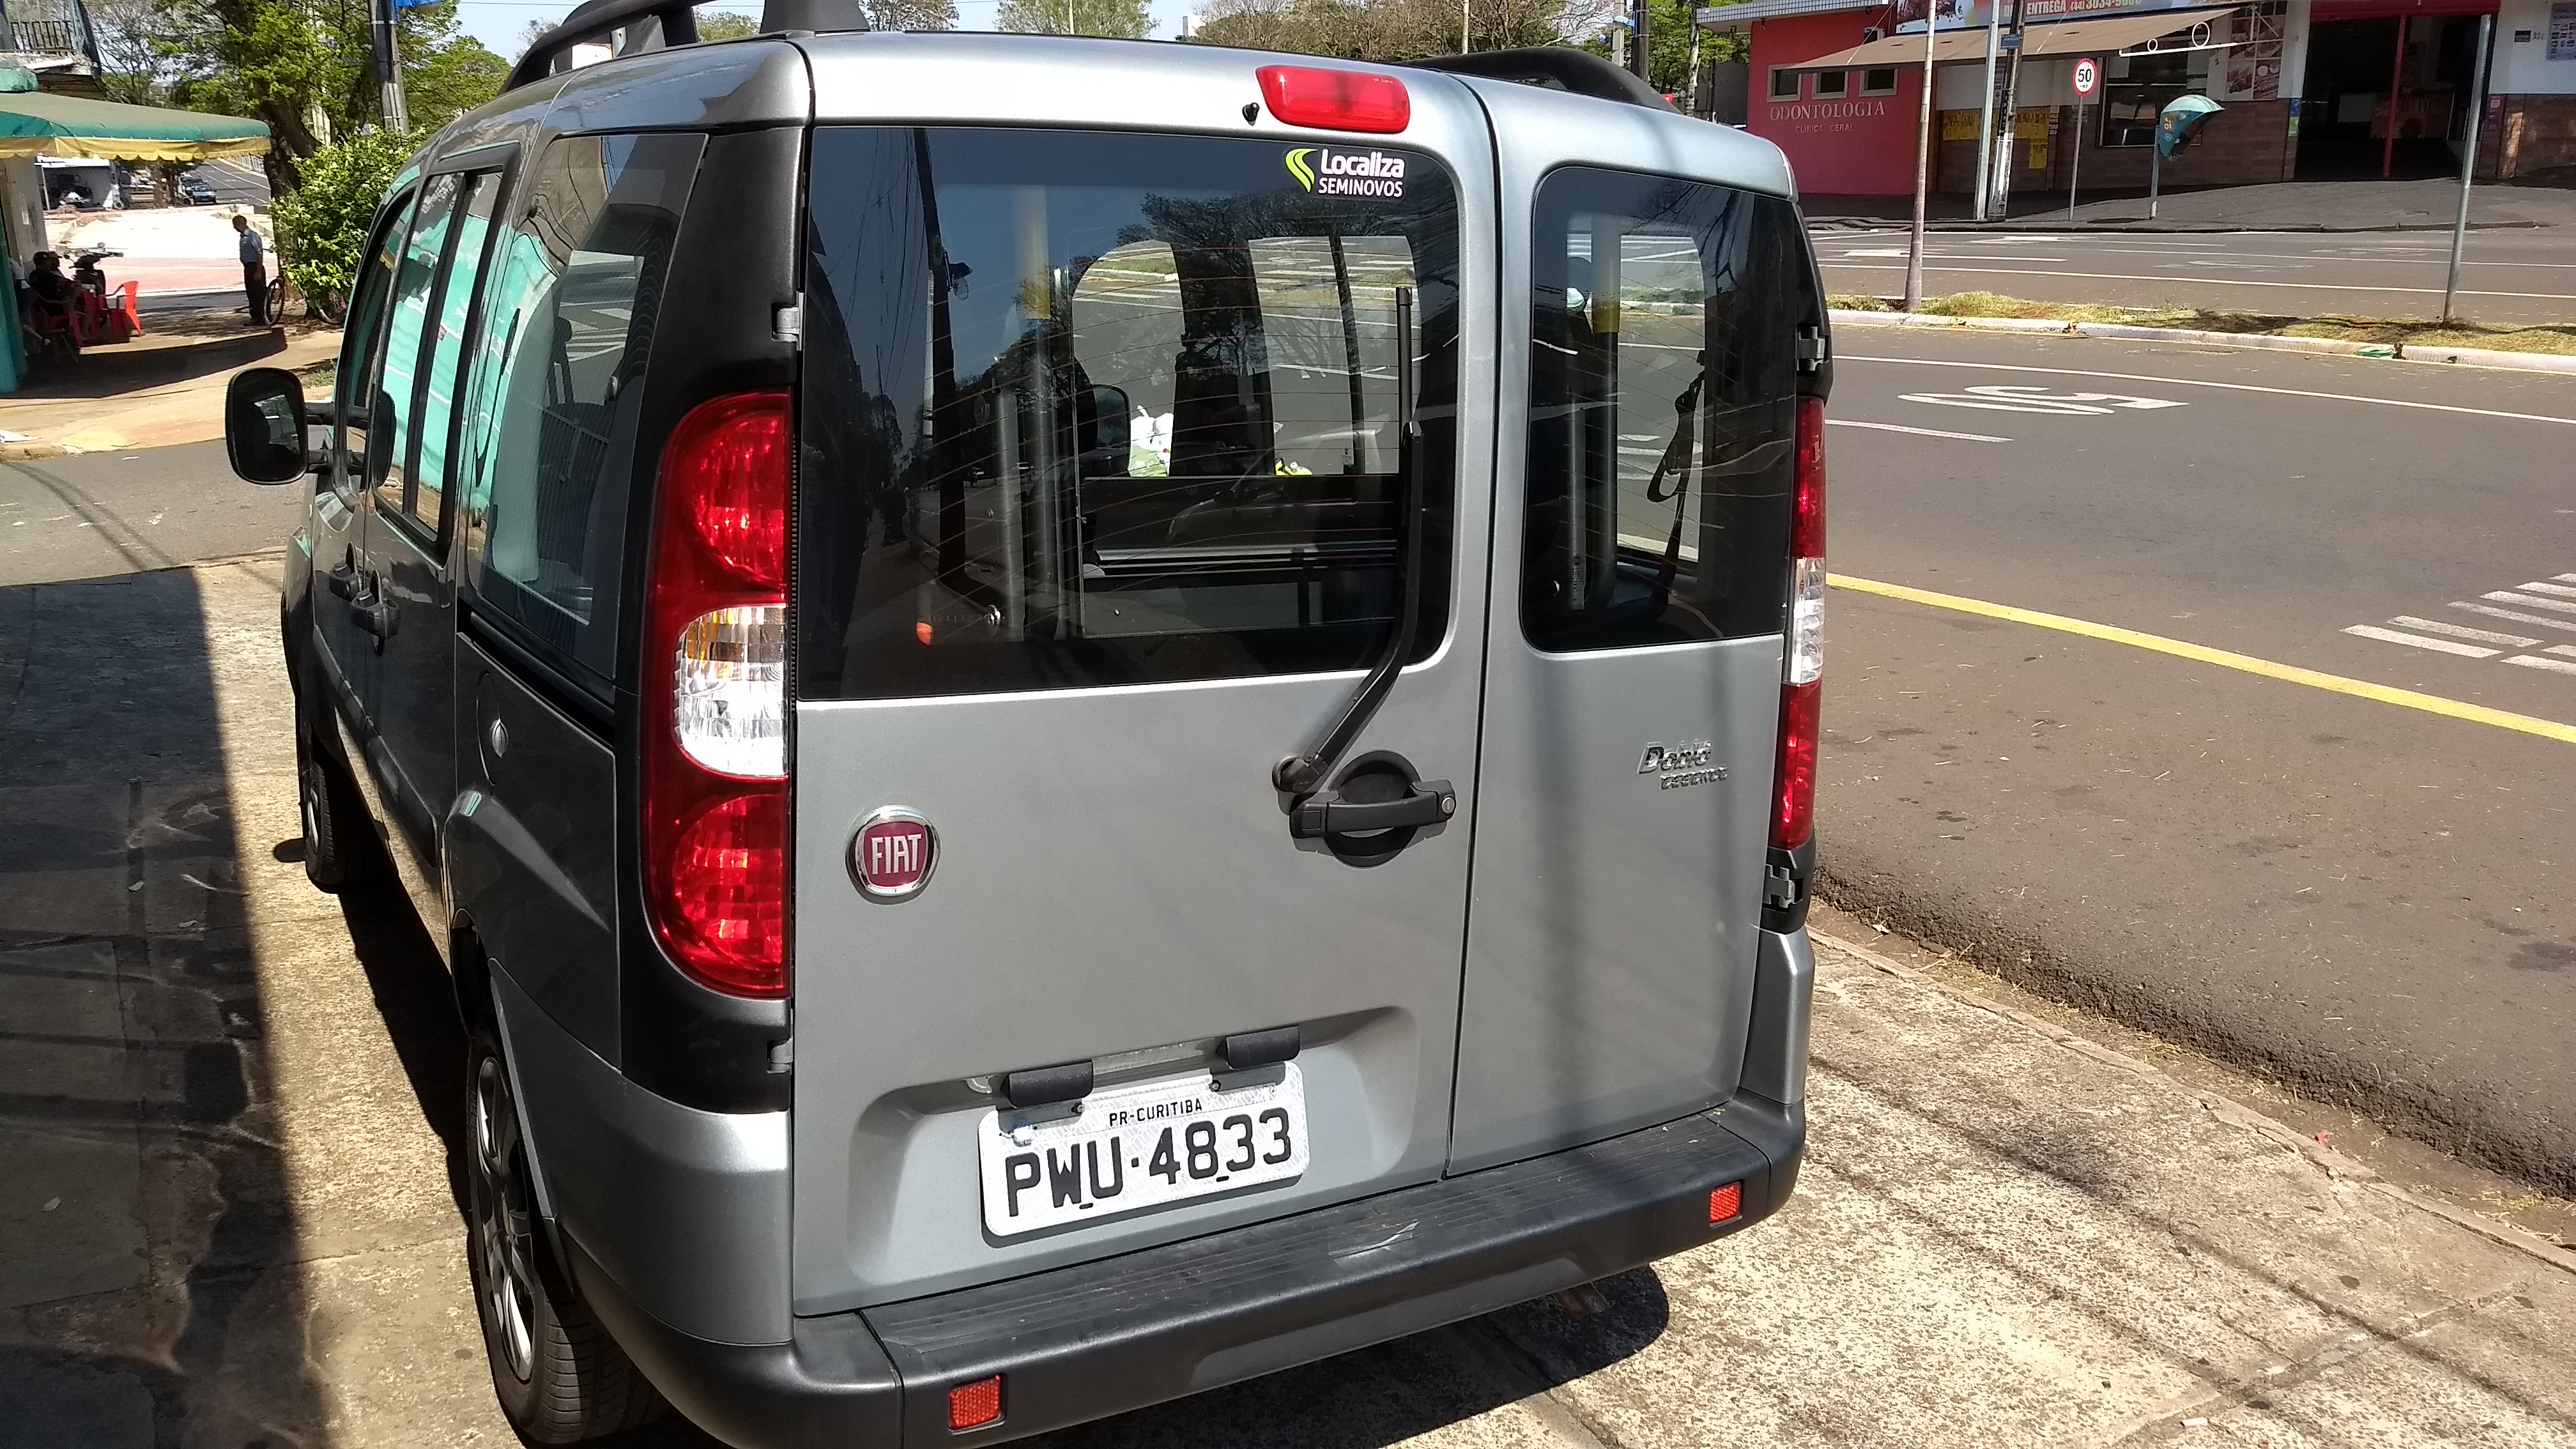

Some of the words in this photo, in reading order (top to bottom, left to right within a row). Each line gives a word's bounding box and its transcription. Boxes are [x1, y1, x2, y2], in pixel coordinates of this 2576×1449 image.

[2027, 0, 2066, 15] ENTREGA
[2078, 68, 2092, 82] 50
[1770, 101, 1885, 121] ODONTOLOGIA
[1830, 123, 1854, 132] GERAL
[1320, 149, 1406, 178] Localiza
[1318, 177, 1403, 197] SEMINOVOS
[871, 834, 922, 875] FIAT
[1108, 1098, 1203, 1127] PR-CURITIBA
